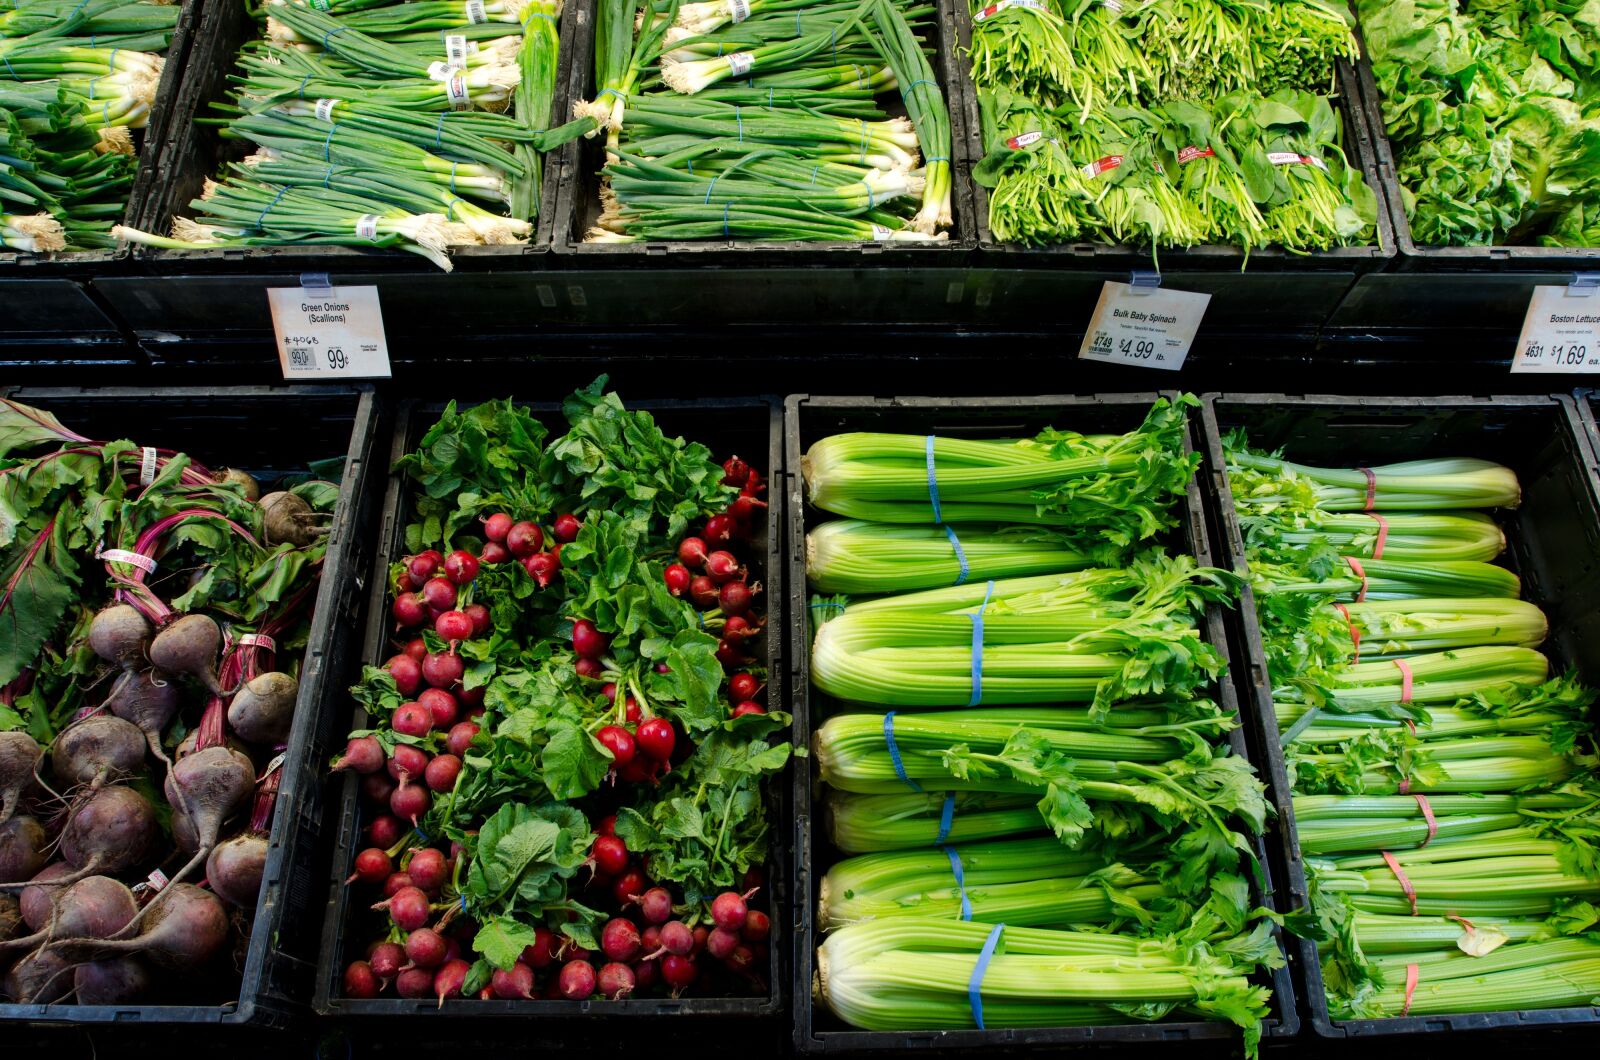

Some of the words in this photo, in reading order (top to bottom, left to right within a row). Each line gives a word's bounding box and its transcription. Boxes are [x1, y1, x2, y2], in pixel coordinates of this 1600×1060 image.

[302, 303, 322, 312] Green
[324, 302, 350, 312] Onions
[308, 313, 346, 325] (Scallions)
[1113, 309, 1129, 318] Bulk
[1130, 311, 1148, 322] Baby
[1149, 313, 1177, 324] Spinach
[1550, 314, 1575, 323] Boston
[1575, 314, 1600, 323] Lettuce
[1093, 336, 1113, 348] 4749
[1118, 338, 1154, 359] $4.99
[1525, 345, 1544, 358] 4631
[327, 349, 350, 370] 99¢
[1155, 353, 1166, 361] lb.
[1550, 345, 1586, 365] $1.69
